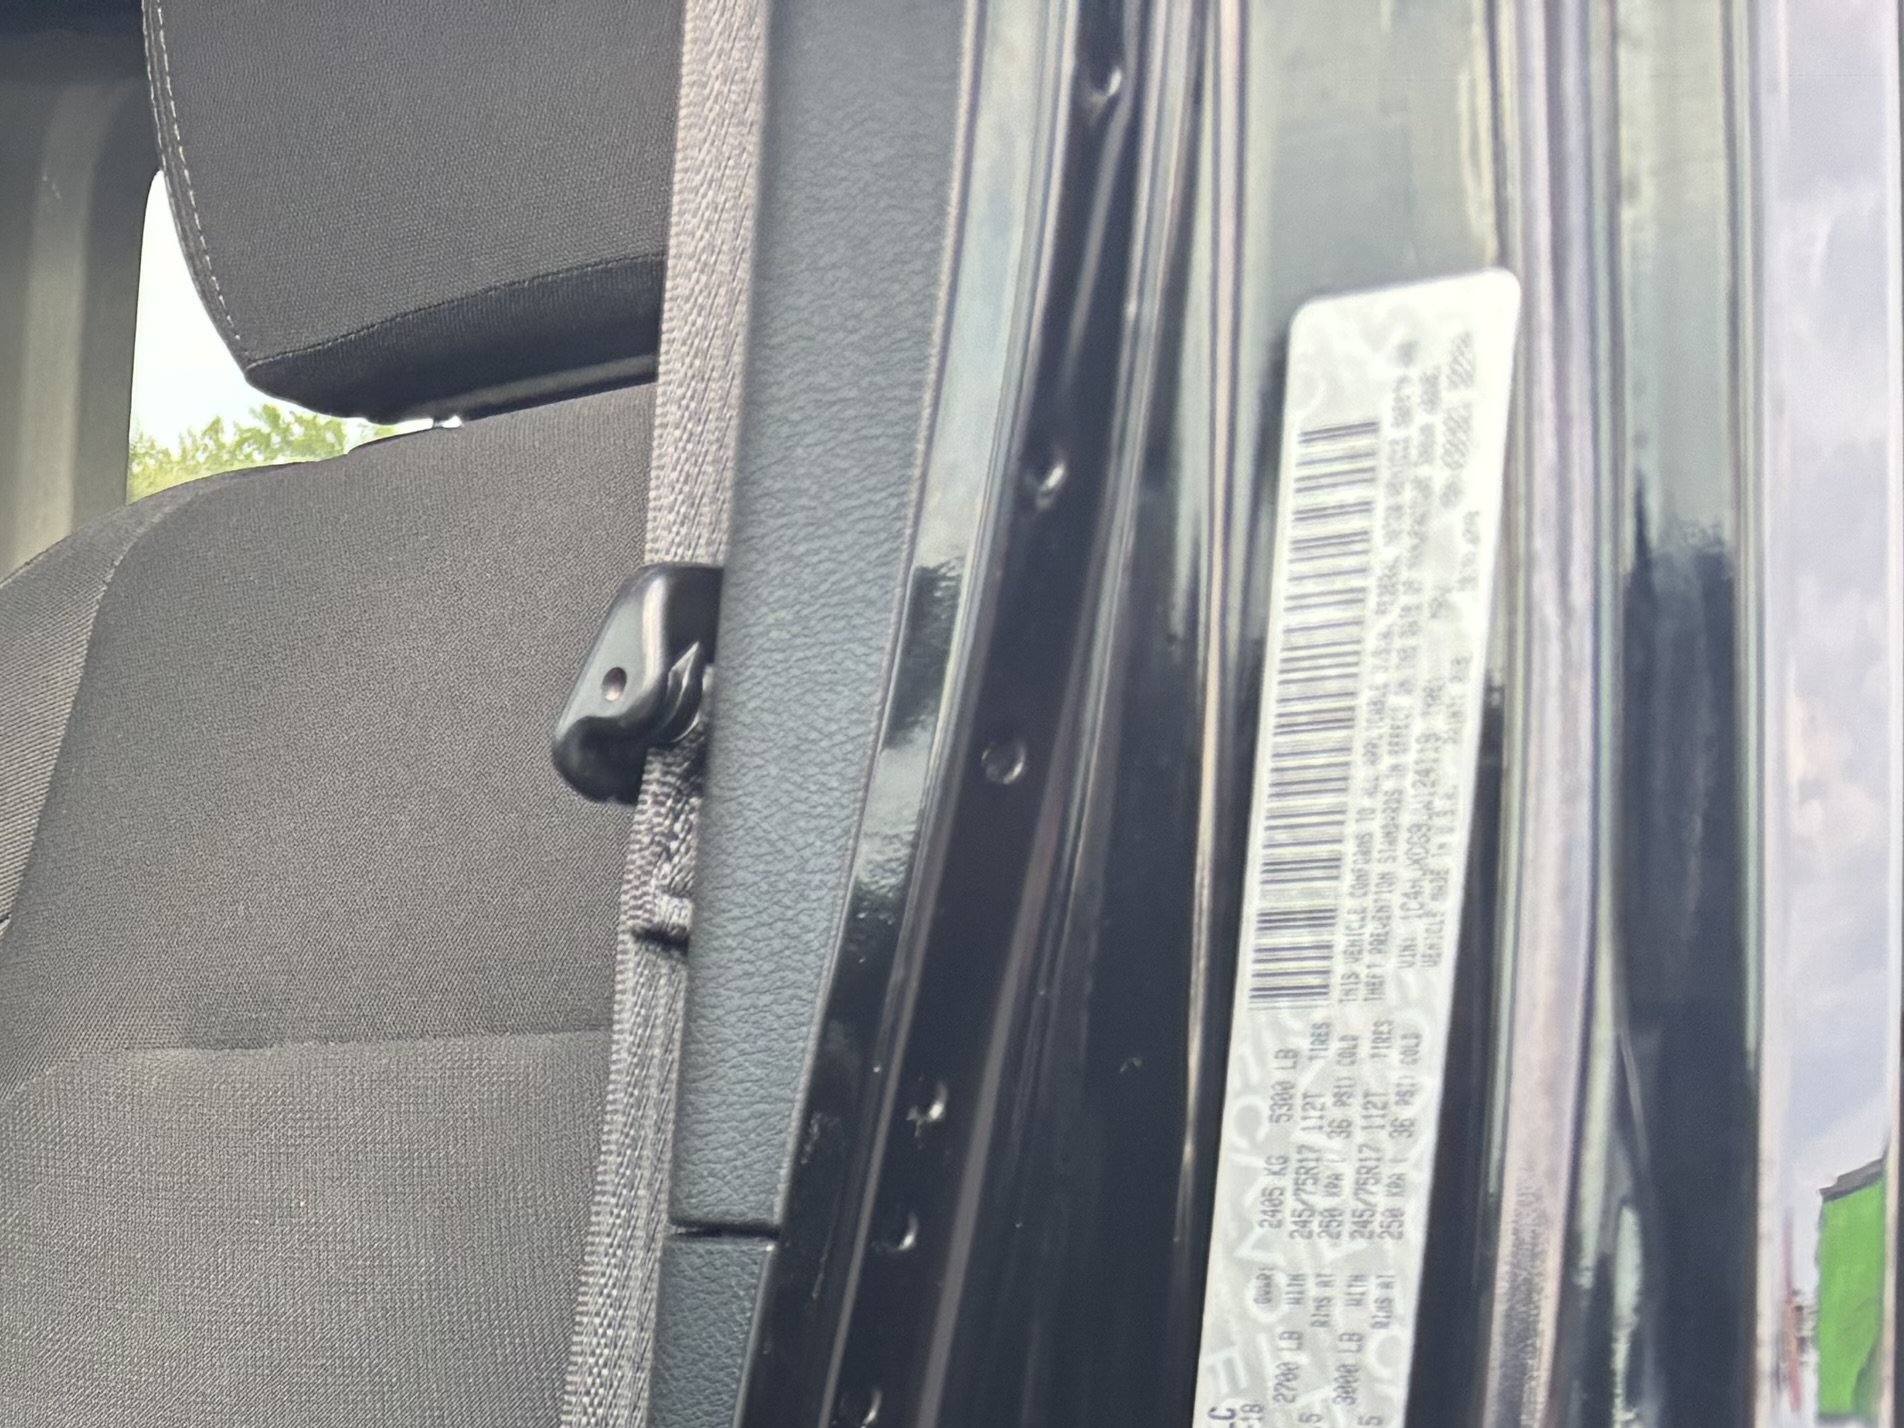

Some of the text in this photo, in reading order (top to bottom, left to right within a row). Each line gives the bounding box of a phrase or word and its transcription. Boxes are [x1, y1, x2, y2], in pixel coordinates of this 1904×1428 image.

[1341, 906, 1367, 964] VEHICLE
[1337, 971, 1361, 1003] THIS
[1362, 962, 1387, 1002] THEFT
[1307, 1021, 1331, 1061] TIRES
[1335, 1033, 1359, 1066] COLD
[1369, 1018, 1394, 1058] TIRES
[1398, 1032, 1423, 1065] COLD
[1267, 1079, 1296, 1124] 5300
[1298, 1091, 1326, 1131] 112T
[1360, 1088, 1389, 1131] 112T
[1288, 1144, 1321, 1240] 245/75R17
[1323, 1173, 1345, 1198] KPA
[1348, 1143, 1384, 1241] 245/75R17
[1384, 1172, 1407, 1198] KPA
[1258, 1185, 1286, 1229] 2405
[1316, 1206, 1343, 1240] 250
[1378, 1206, 1406, 1240] 250
[1285, 1272, 1308, 1305] WITH
[1345, 1273, 1367, 1307] WITH
[1310, 1295, 1333, 1328] RIMS
[1371, 1296, 1394, 1329] RIMS
[1272, 1361, 1300, 1404] 2700
[1333, 1362, 1361, 1406] 3000
